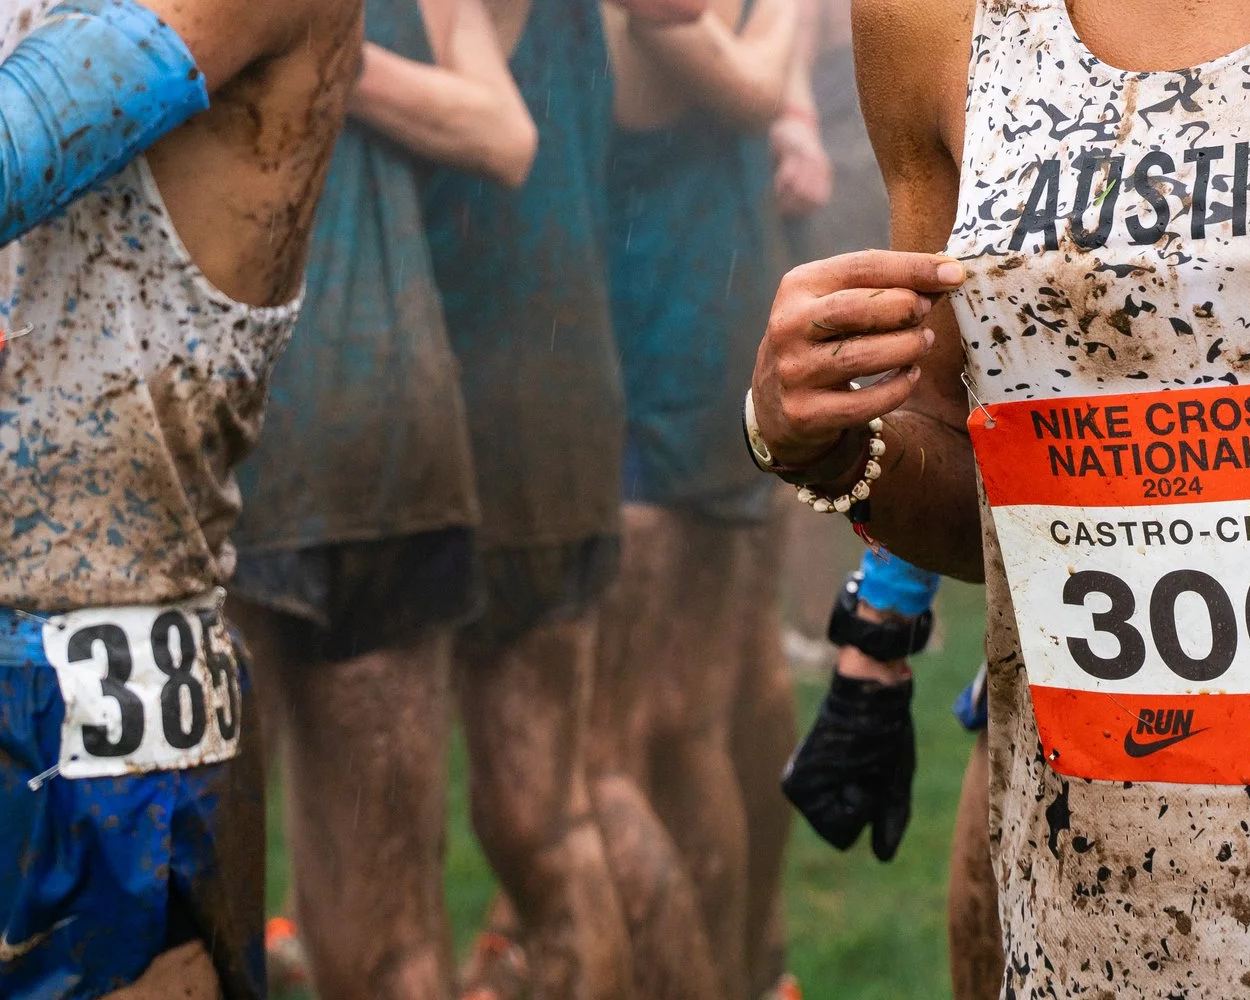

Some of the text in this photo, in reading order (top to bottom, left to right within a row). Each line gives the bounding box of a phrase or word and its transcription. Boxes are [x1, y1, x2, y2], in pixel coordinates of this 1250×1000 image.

[1032, 405, 1132, 440] NIKE
[1142, 476, 1203, 498] 2024
[67, 608, 240, 757] 385
[1136, 709, 1194, 737] RUN
